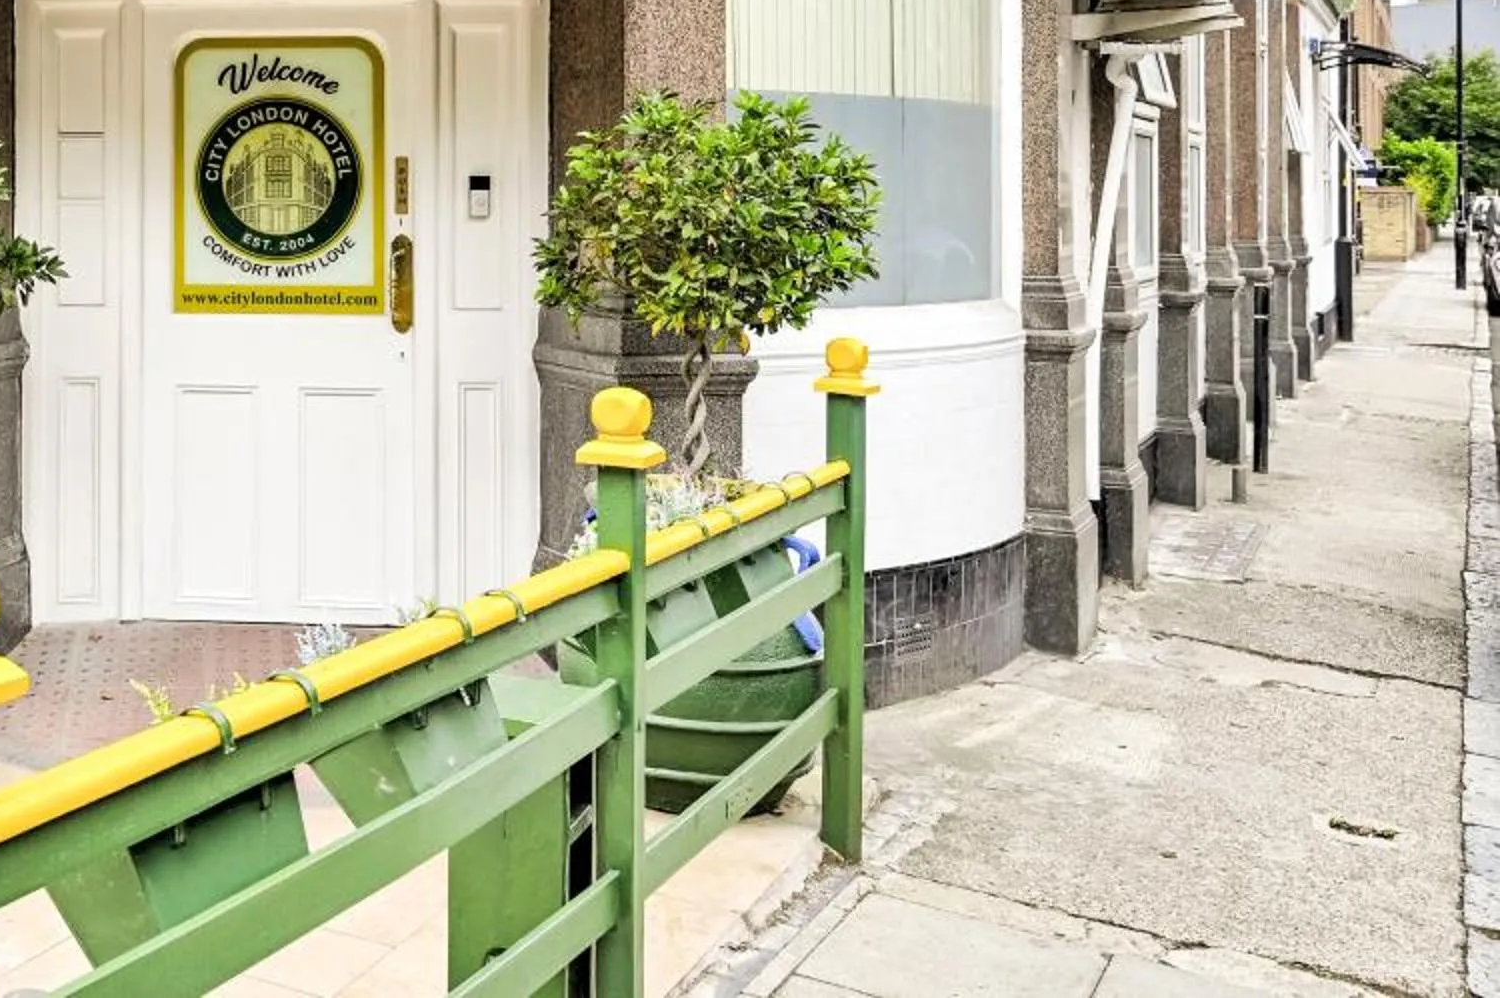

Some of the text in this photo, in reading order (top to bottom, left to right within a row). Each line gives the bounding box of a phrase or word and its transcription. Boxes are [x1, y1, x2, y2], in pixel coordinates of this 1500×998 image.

[217, 52, 340, 95] Welcome
[205, 106, 353, 182] CITY LONDON HOTEL
[202, 234, 357, 278] COMFORT WITH LOVE
[242, 232, 316, 253] EST. 2004
[181, 289, 378, 308] www.citylondonhotel.com
